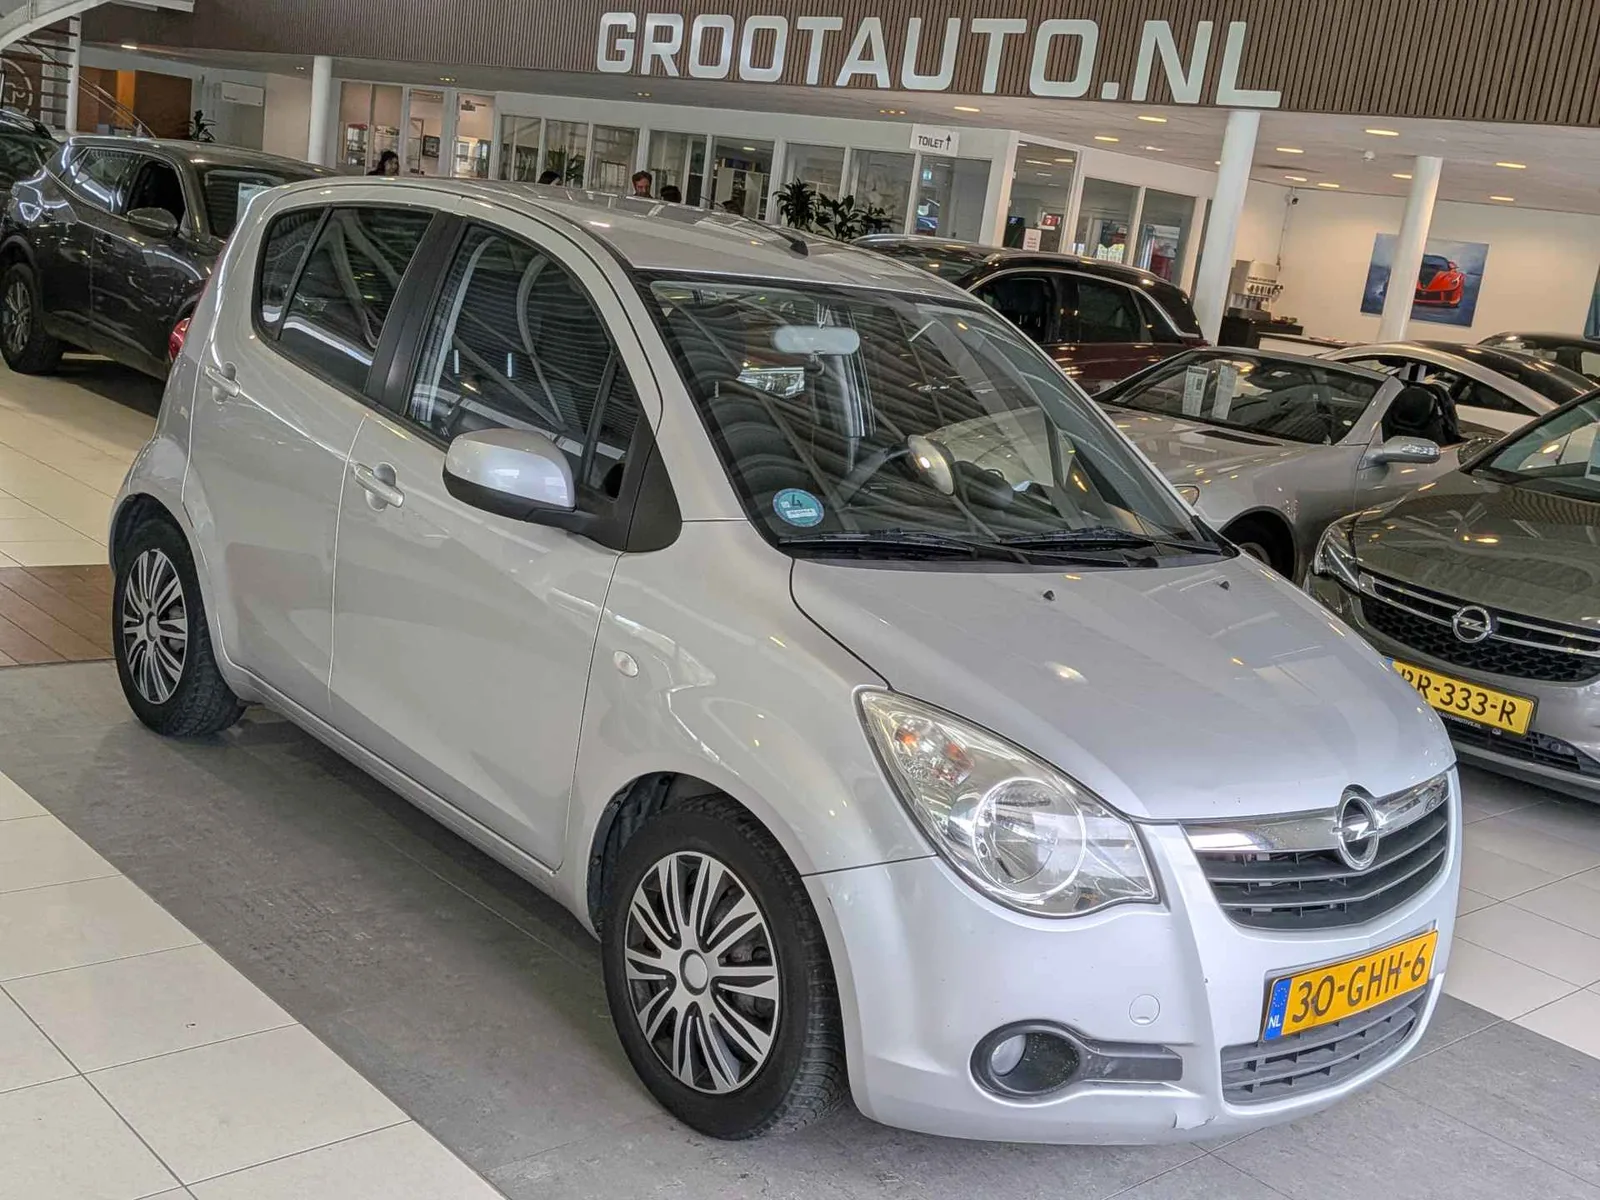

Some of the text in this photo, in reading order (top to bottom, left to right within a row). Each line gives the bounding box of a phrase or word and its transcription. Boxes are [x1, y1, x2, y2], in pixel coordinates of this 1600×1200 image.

[597, 12, 1282, 108] GROOTAUTO.NL
[917, 135, 945, 149] TOILET
[1292, 943, 1427, 1023] 30-GHH-6
[1268, 1015, 1281, 1029] NL
